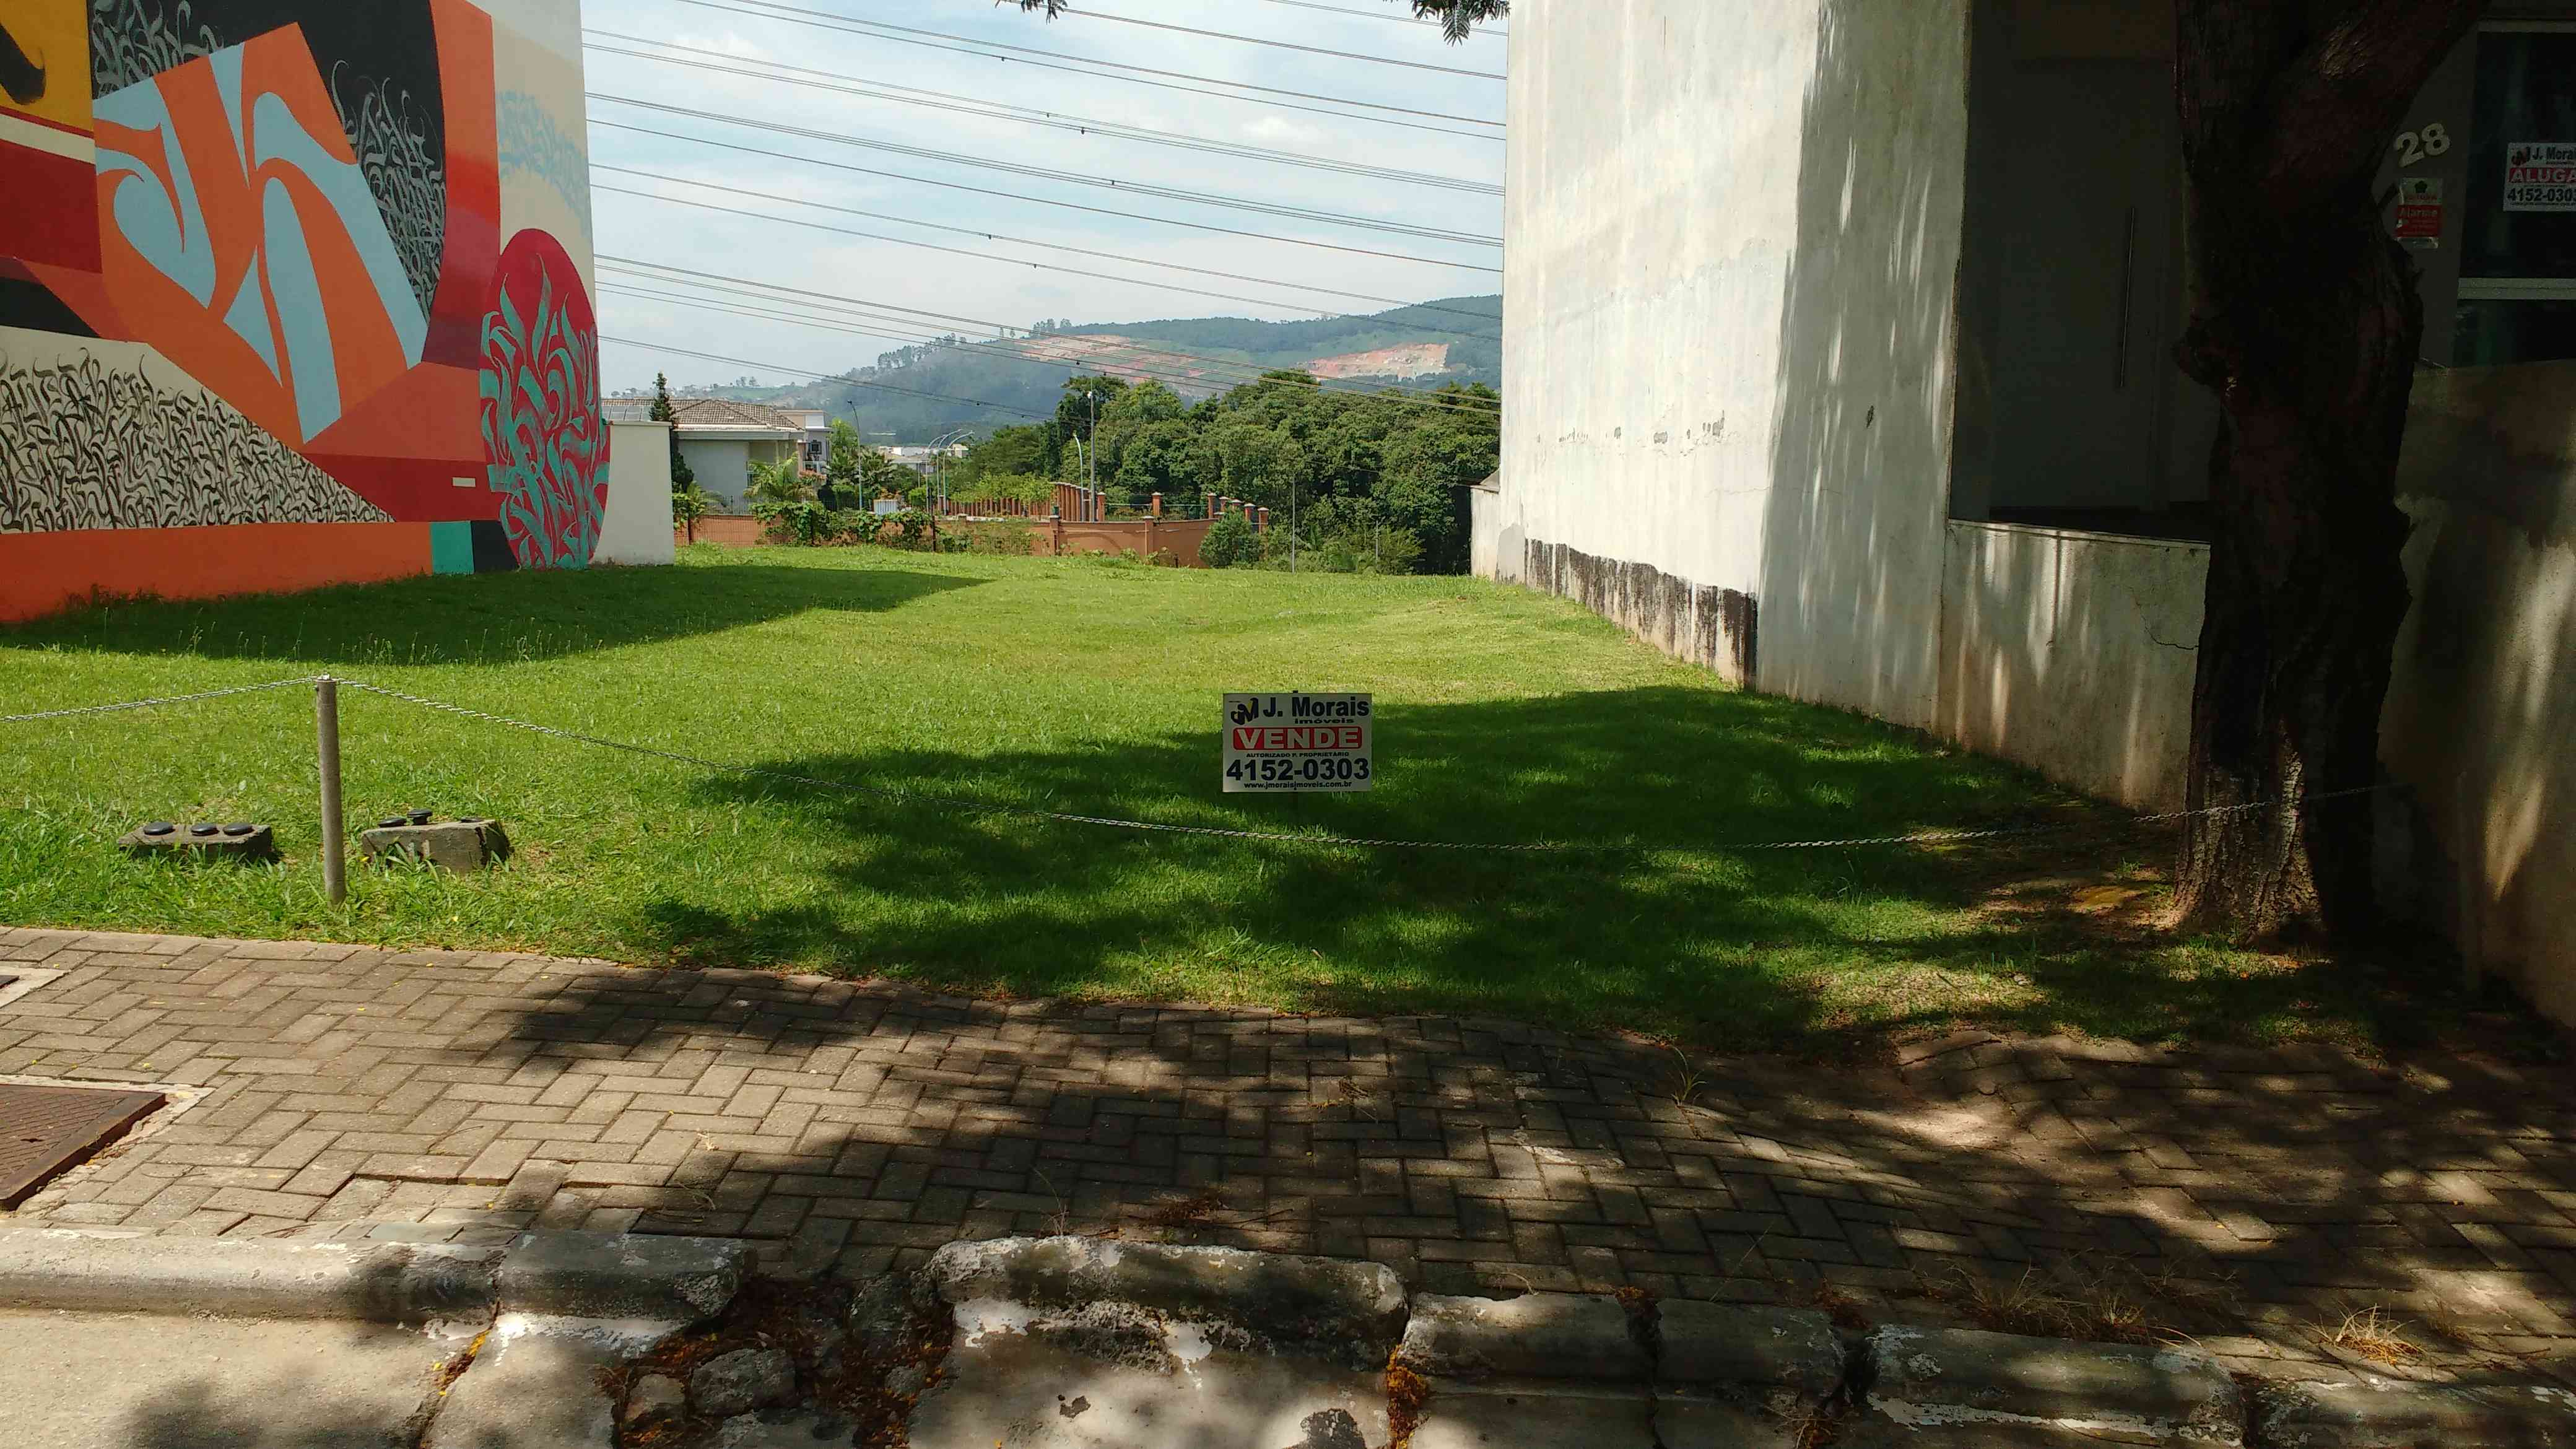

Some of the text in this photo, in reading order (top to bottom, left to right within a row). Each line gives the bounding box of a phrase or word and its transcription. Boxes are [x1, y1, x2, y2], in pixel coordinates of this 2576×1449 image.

[2394, 123, 2450, 167] 28
[2533, 147, 2543, 160] J.
[1263, 697, 1283, 717] J.
[1292, 697, 1370, 717] Morais
[1237, 728, 1359, 749] VENDE
[1226, 758, 1370, 781] 4152-0303
